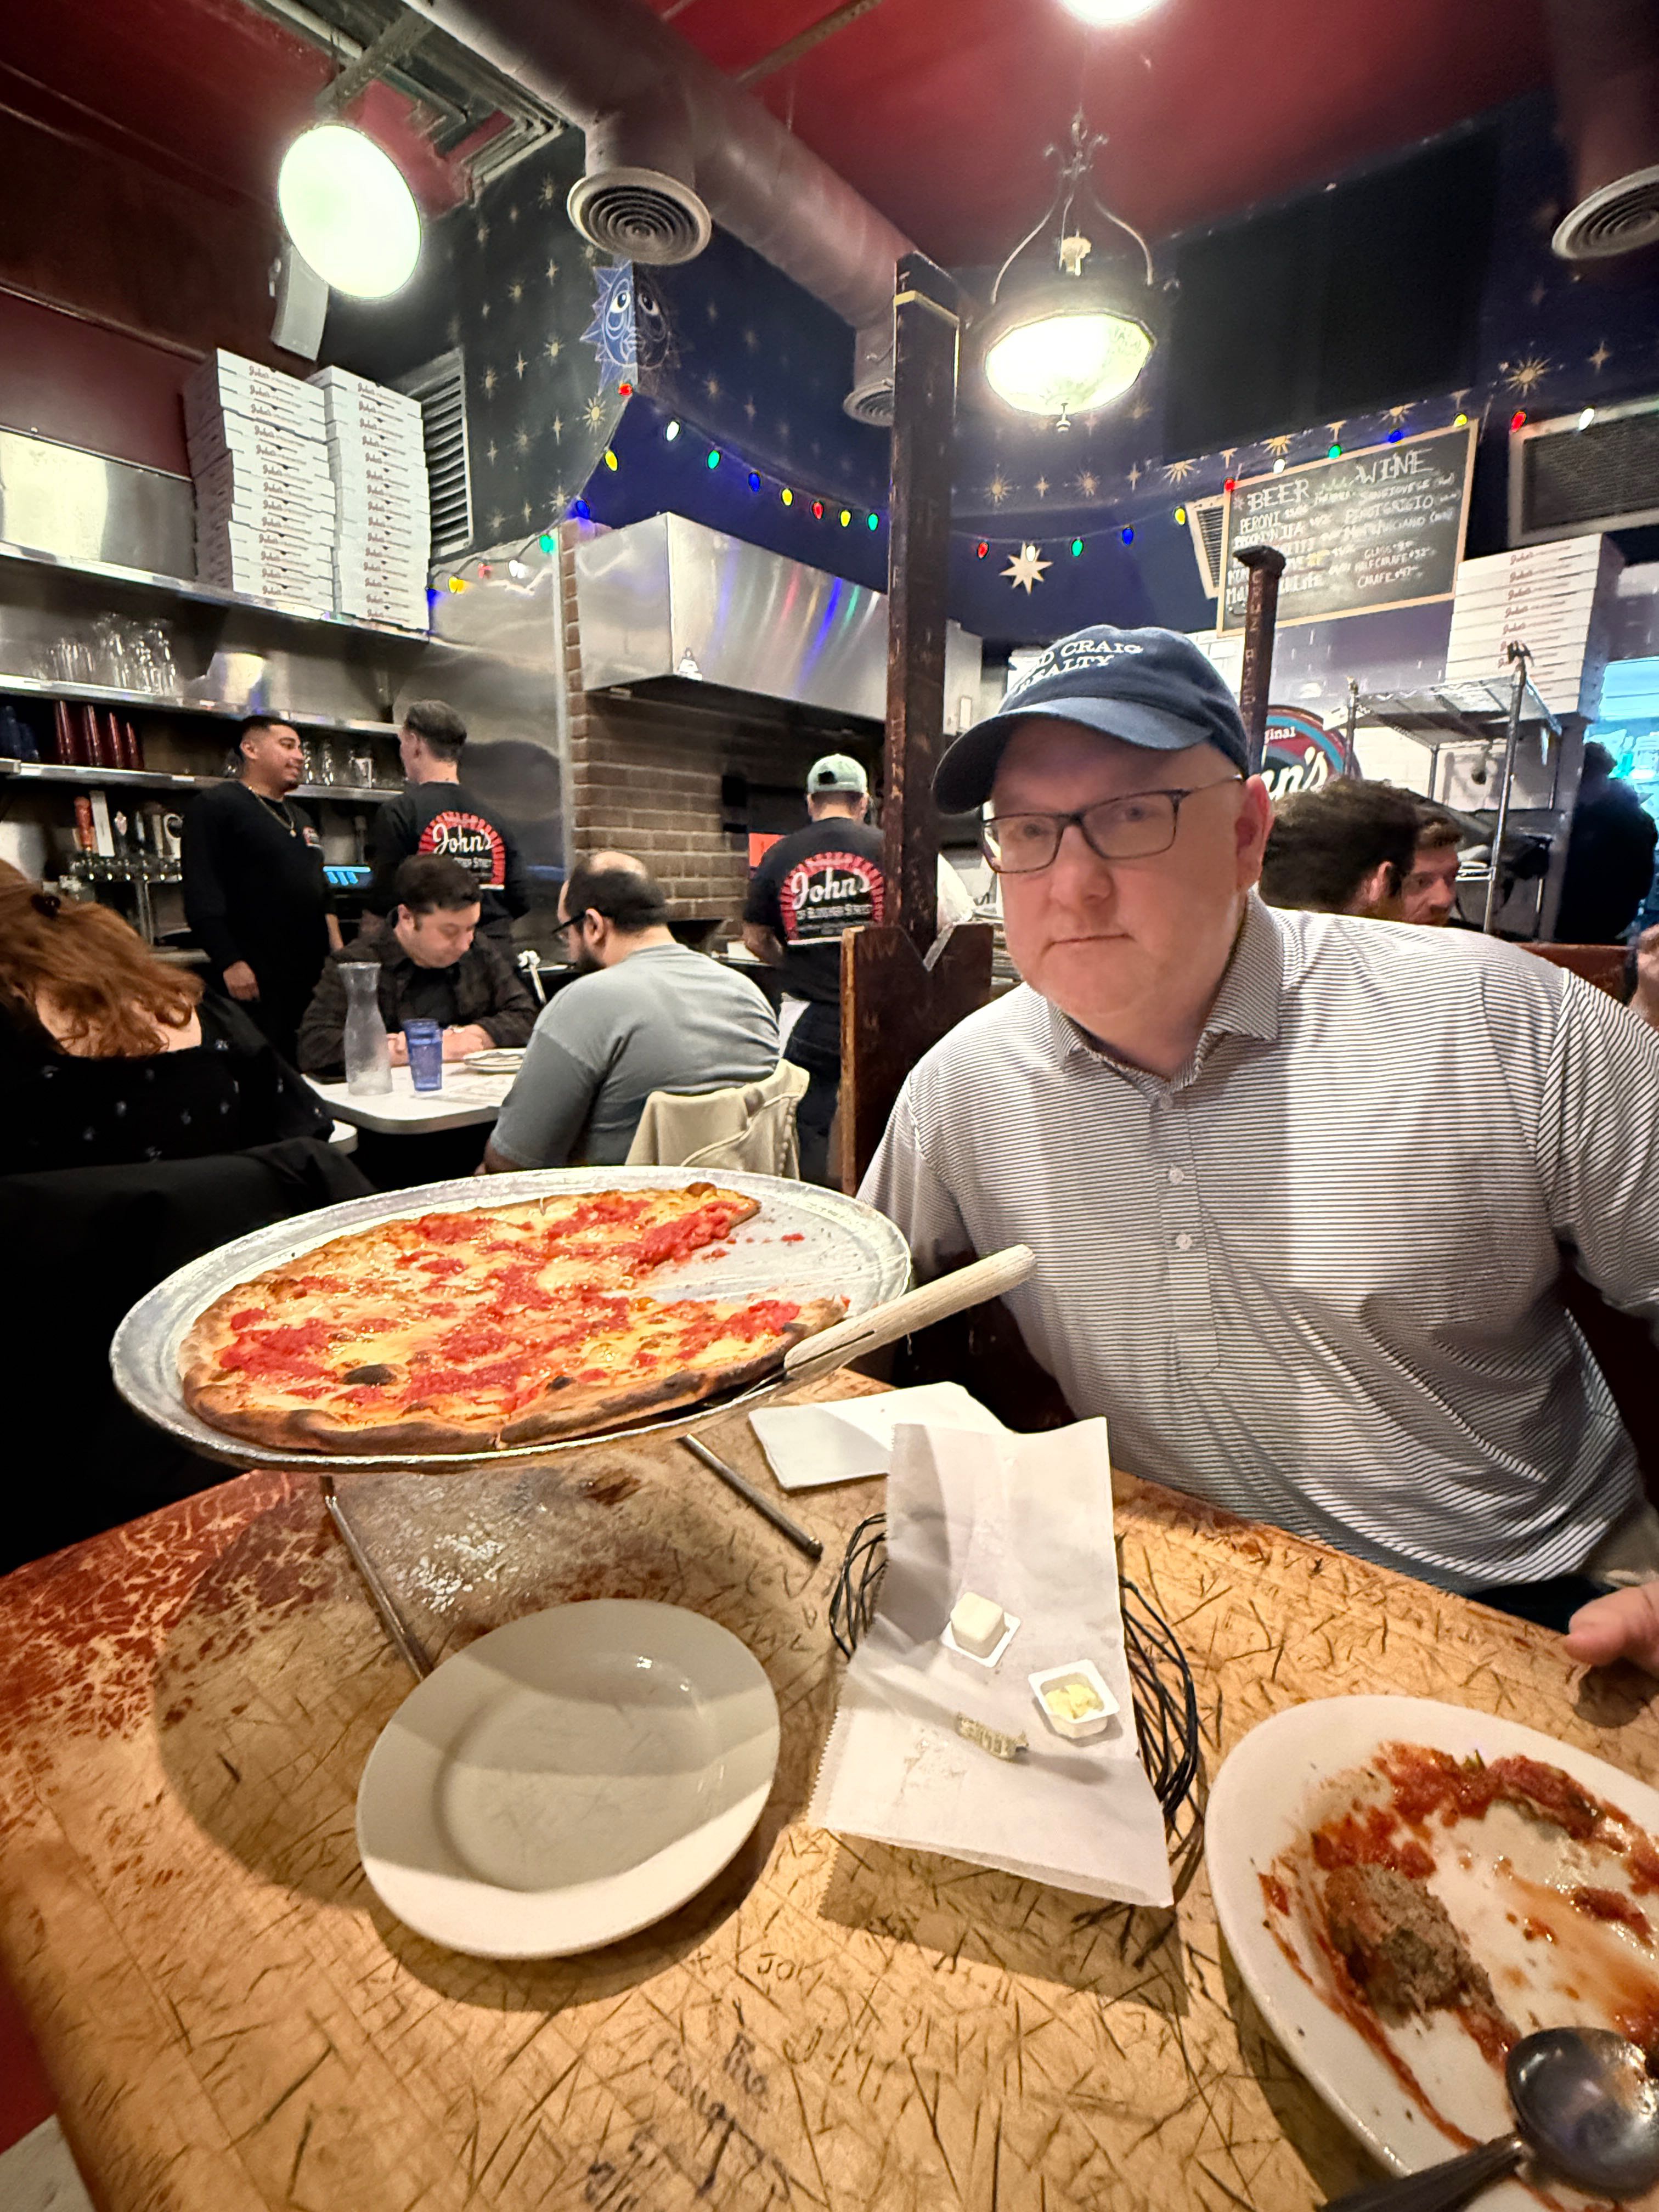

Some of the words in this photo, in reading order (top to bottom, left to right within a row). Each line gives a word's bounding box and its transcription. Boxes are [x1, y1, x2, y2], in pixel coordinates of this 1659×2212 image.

[1355, 448, 1434, 483] WINE
[1247, 479, 1310, 512] BEER
[1240, 511, 1282, 534] PERONI
[1060, 640, 1144, 657] CRAIG
[1013, 655, 1115, 698] REALTY
[1264, 726, 1296, 744] ginal
[432, 822, 494, 855] John's
